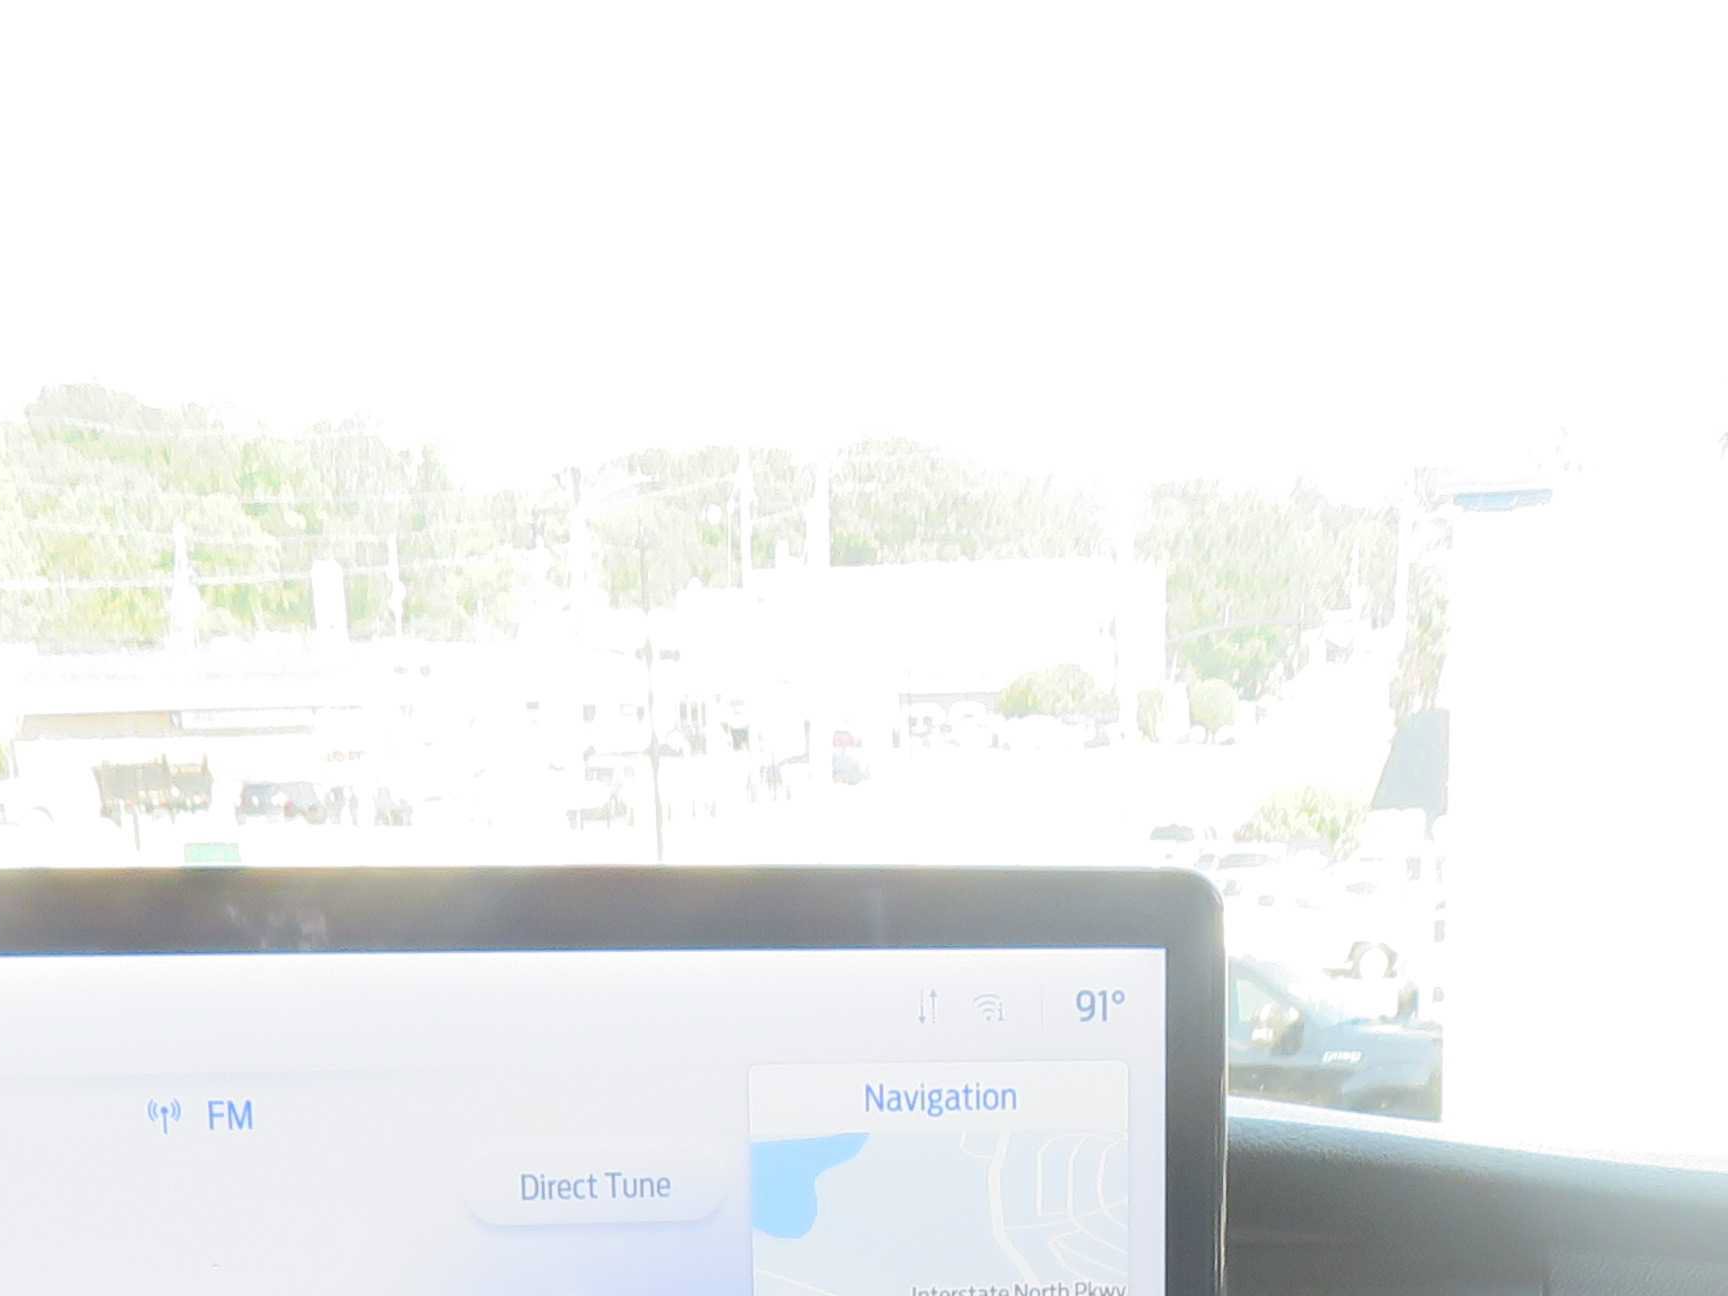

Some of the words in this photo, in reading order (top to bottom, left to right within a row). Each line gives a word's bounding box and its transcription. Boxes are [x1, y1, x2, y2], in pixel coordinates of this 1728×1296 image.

[1075, 987, 1128, 1022] 91°
[207, 1099, 255, 1131] FM
[864, 1081, 1018, 1119] Navigation
[519, 1171, 598, 1202] Direct
[603, 1171, 672, 1199] Tune
